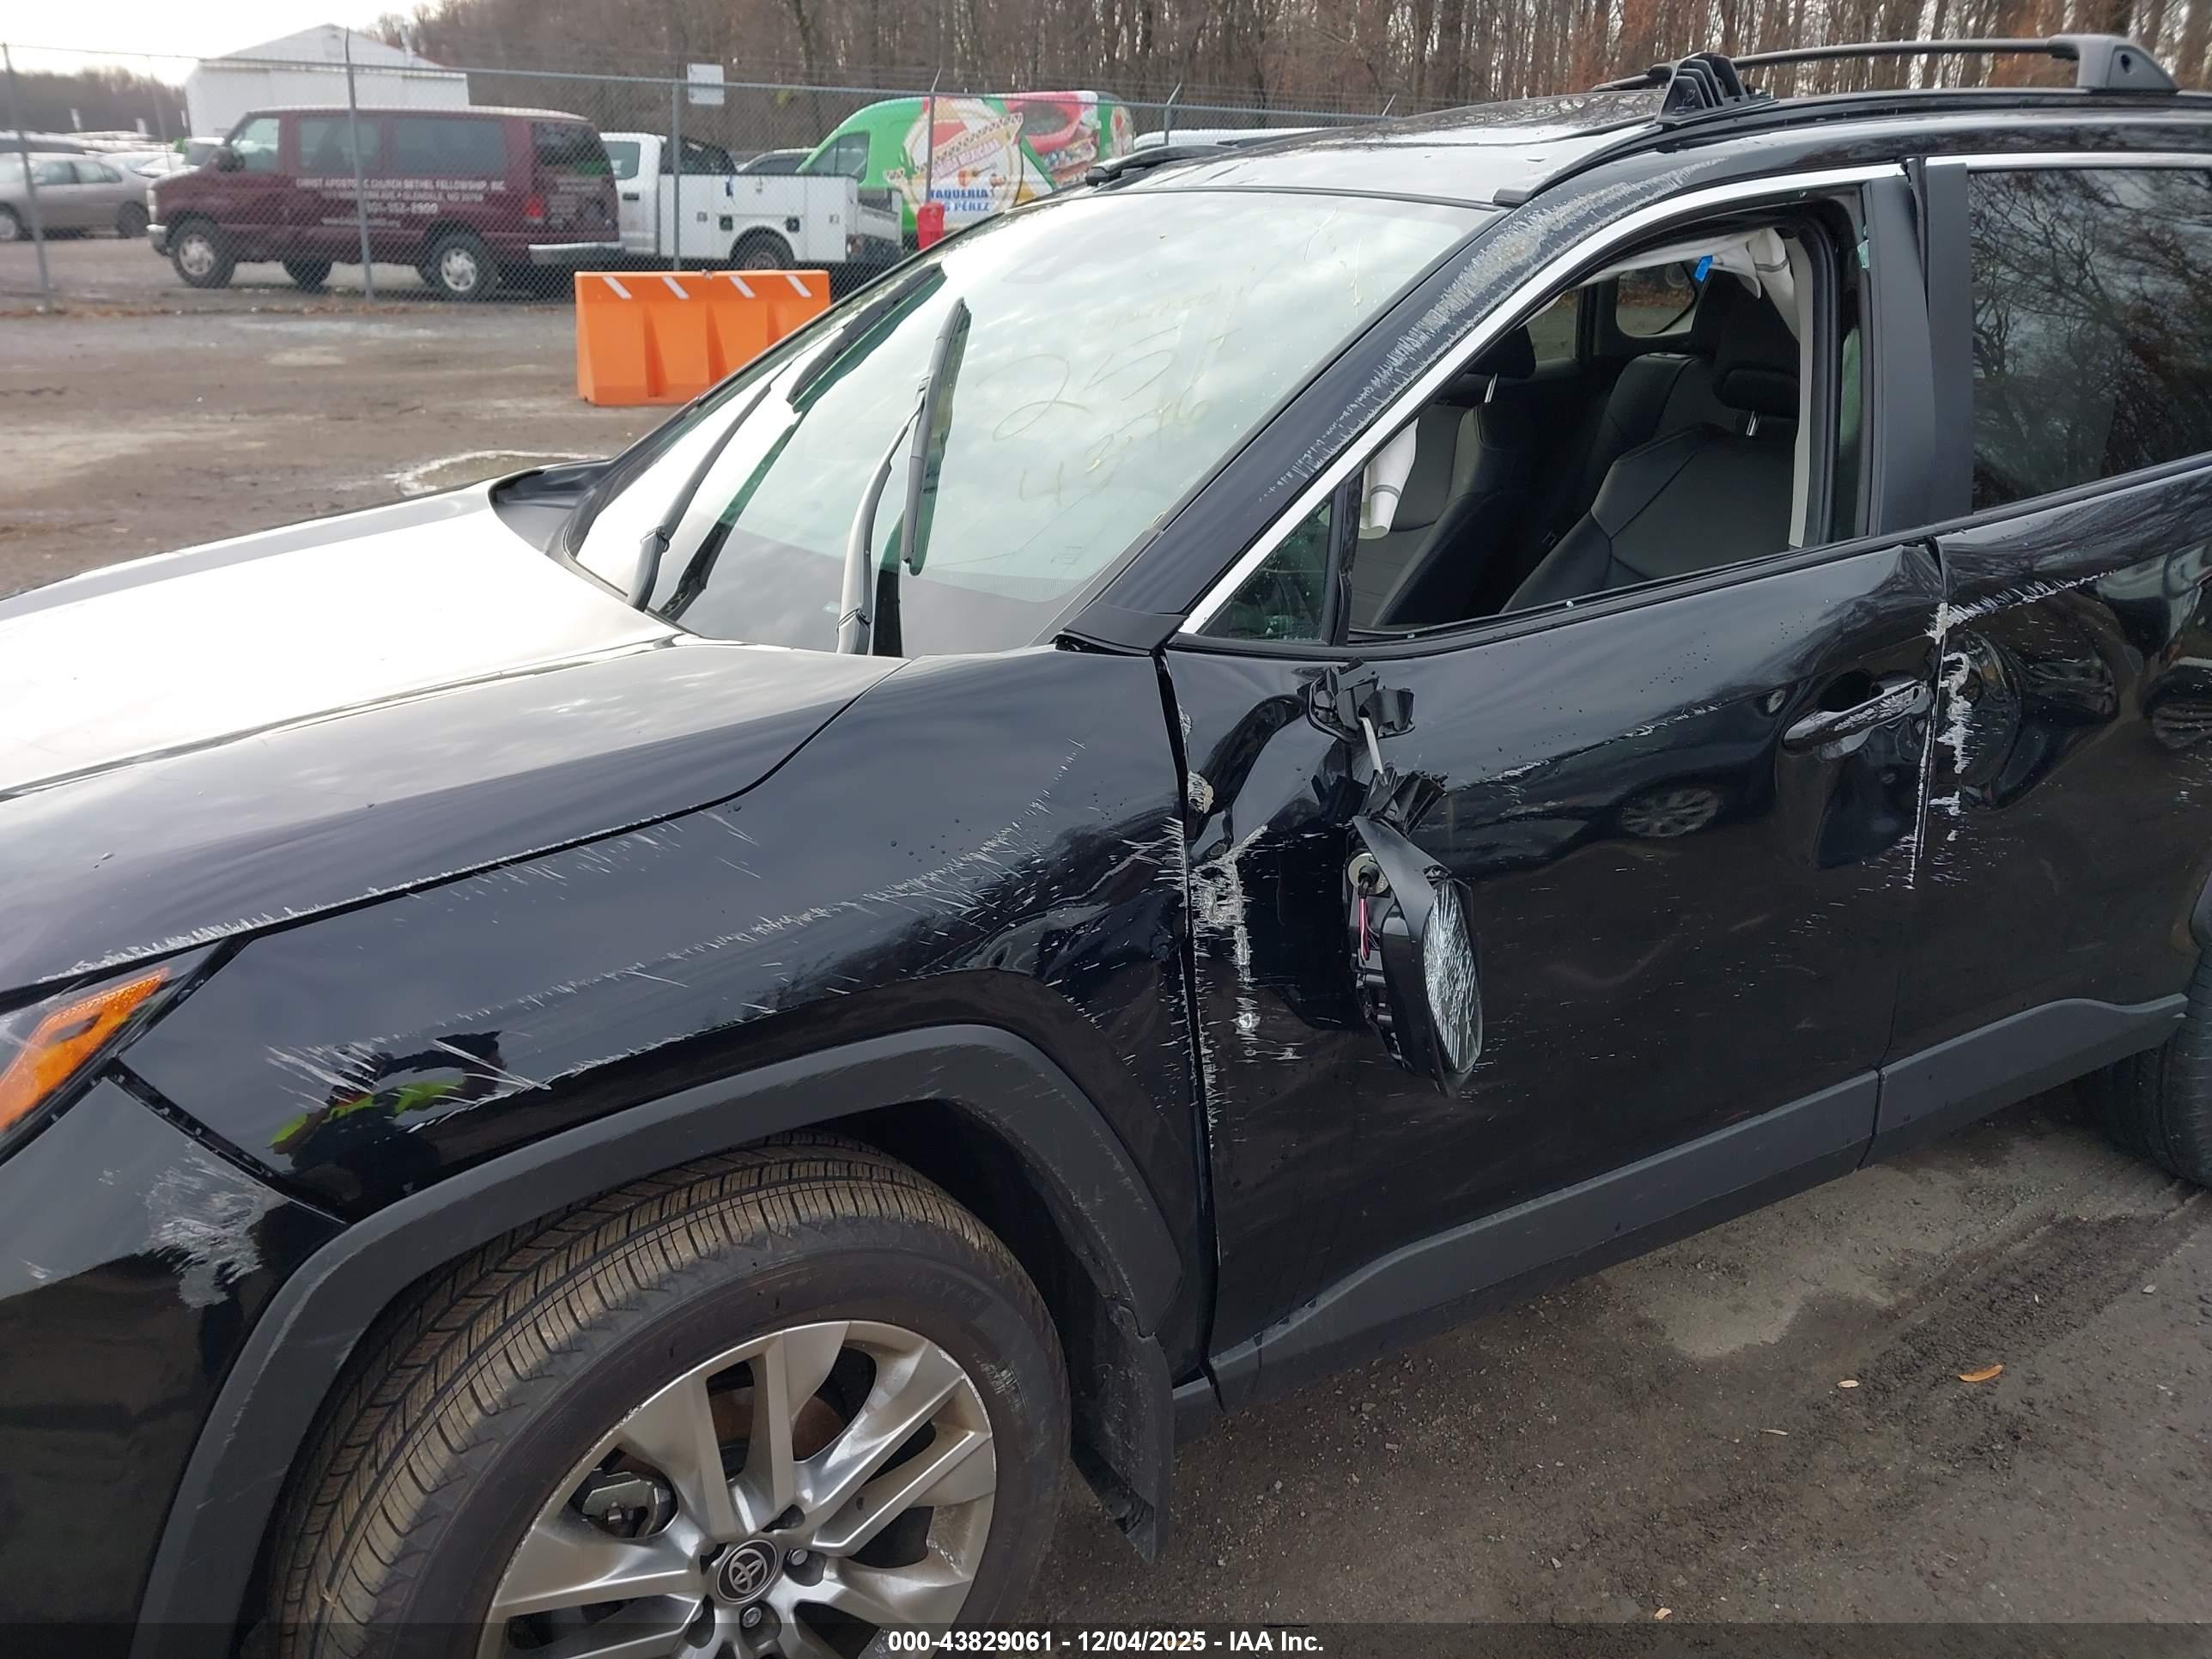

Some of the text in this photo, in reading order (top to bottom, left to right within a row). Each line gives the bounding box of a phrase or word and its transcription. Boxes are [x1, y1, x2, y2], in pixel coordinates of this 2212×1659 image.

[325, 179, 370, 189] APOSTOC
[371, 179, 402, 189] CHURCH
[404, 179, 434, 190] BETHEL
